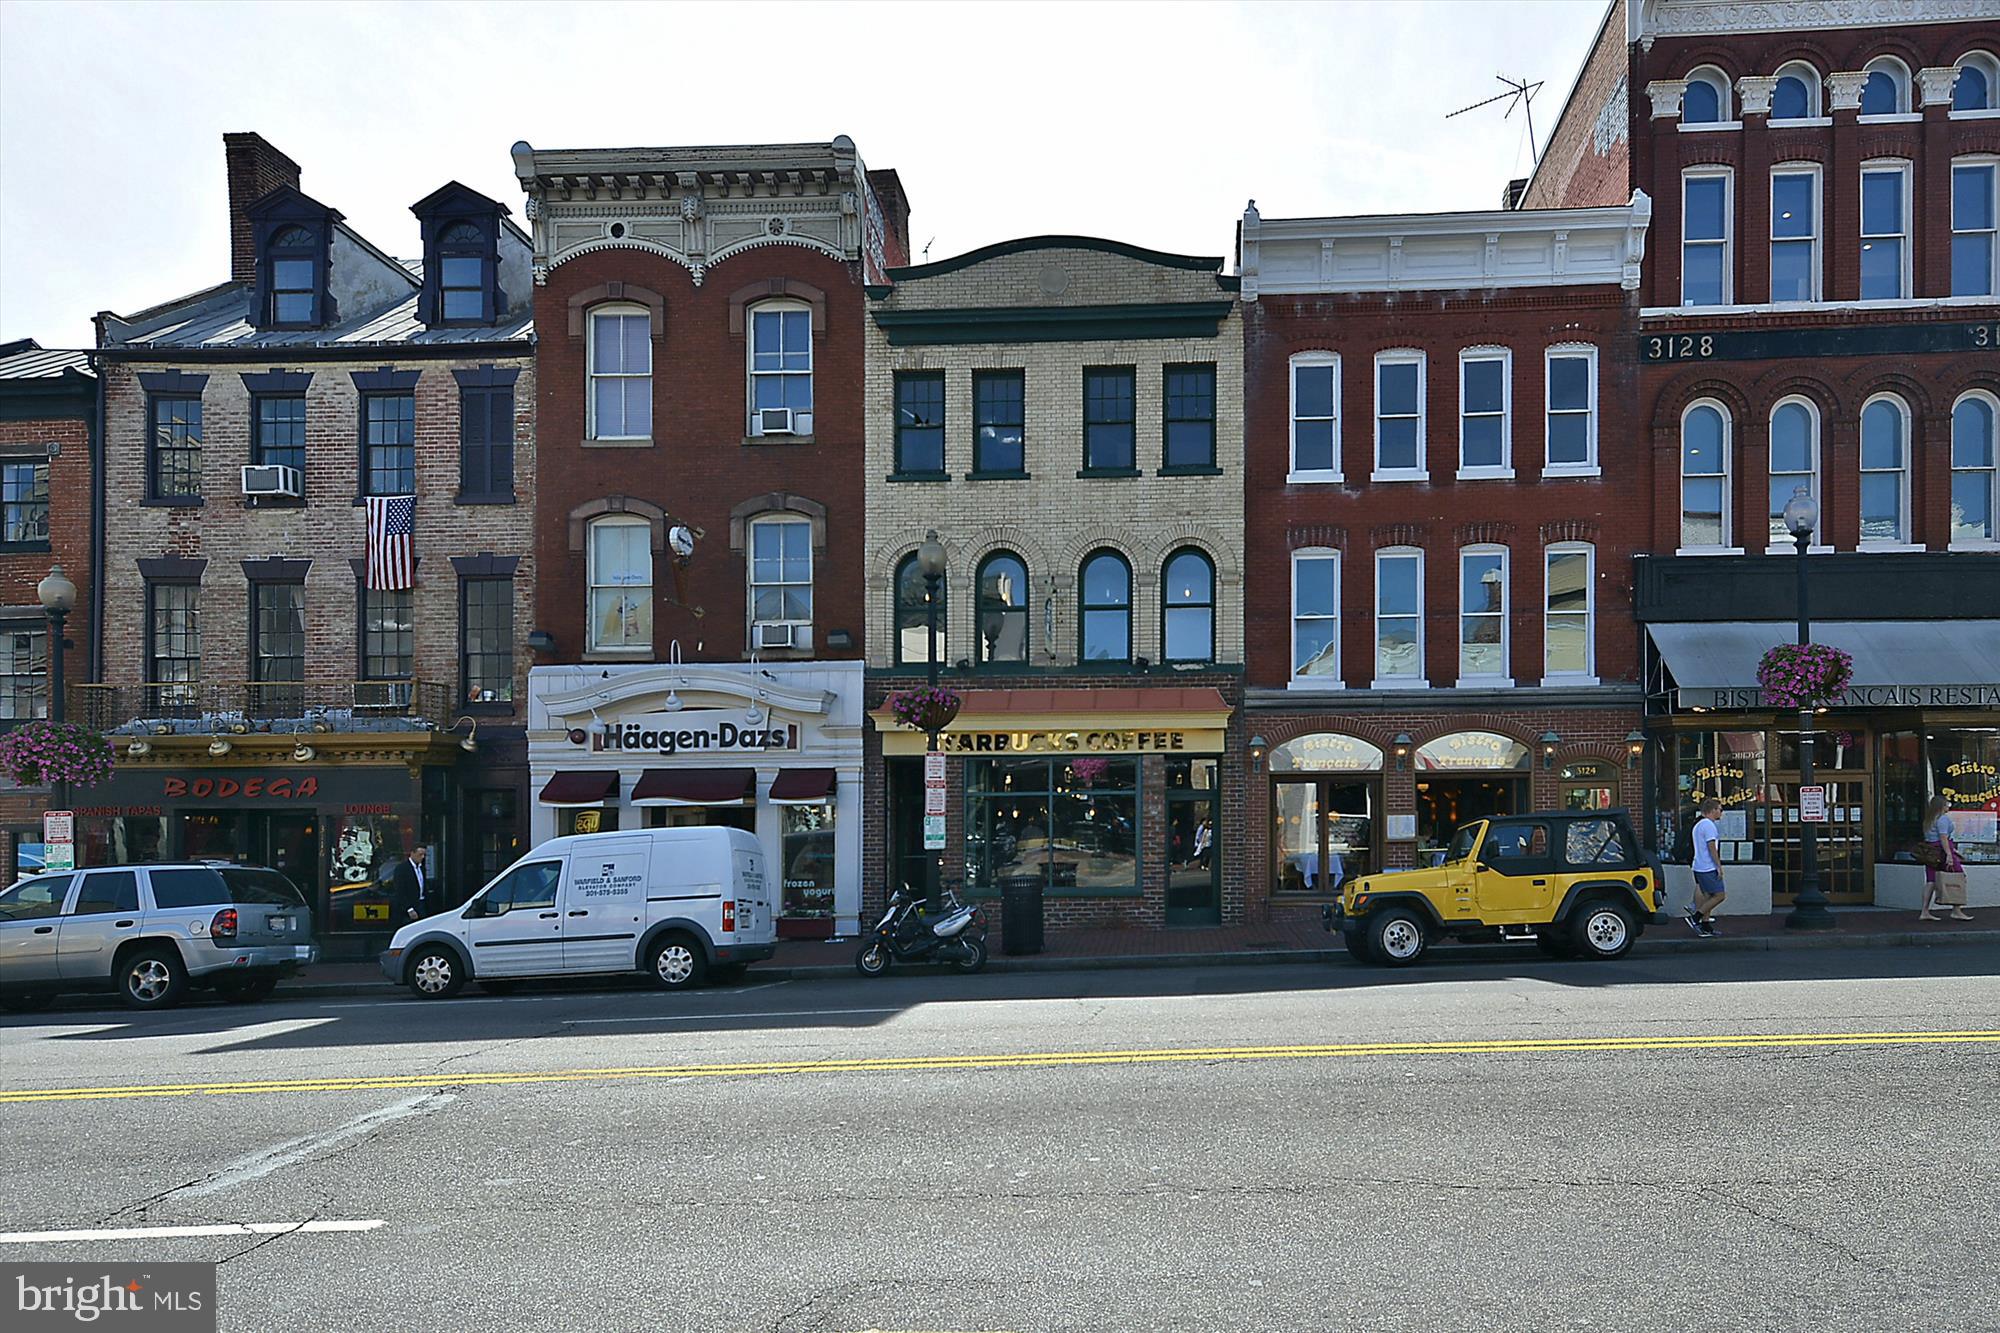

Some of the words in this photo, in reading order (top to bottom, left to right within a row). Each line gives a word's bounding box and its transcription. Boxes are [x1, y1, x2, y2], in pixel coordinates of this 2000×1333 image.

[1649, 336, 1714, 358] 3128
[604, 722, 785, 755] Häagen-Dazs
[1086, 732, 1185, 751] COFFEE
[1575, 767, 1597, 775] 3124
[1696, 765, 1744, 780] Bistro
[1946, 761, 1996, 777] Bistro
[162, 775, 319, 799] BODEGA
[73, 805, 122, 816] SPANISH
[127, 805, 161, 816] TAPAS
[344, 804, 391, 814] LOUNGE
[783, 879, 815, 888] frozen
